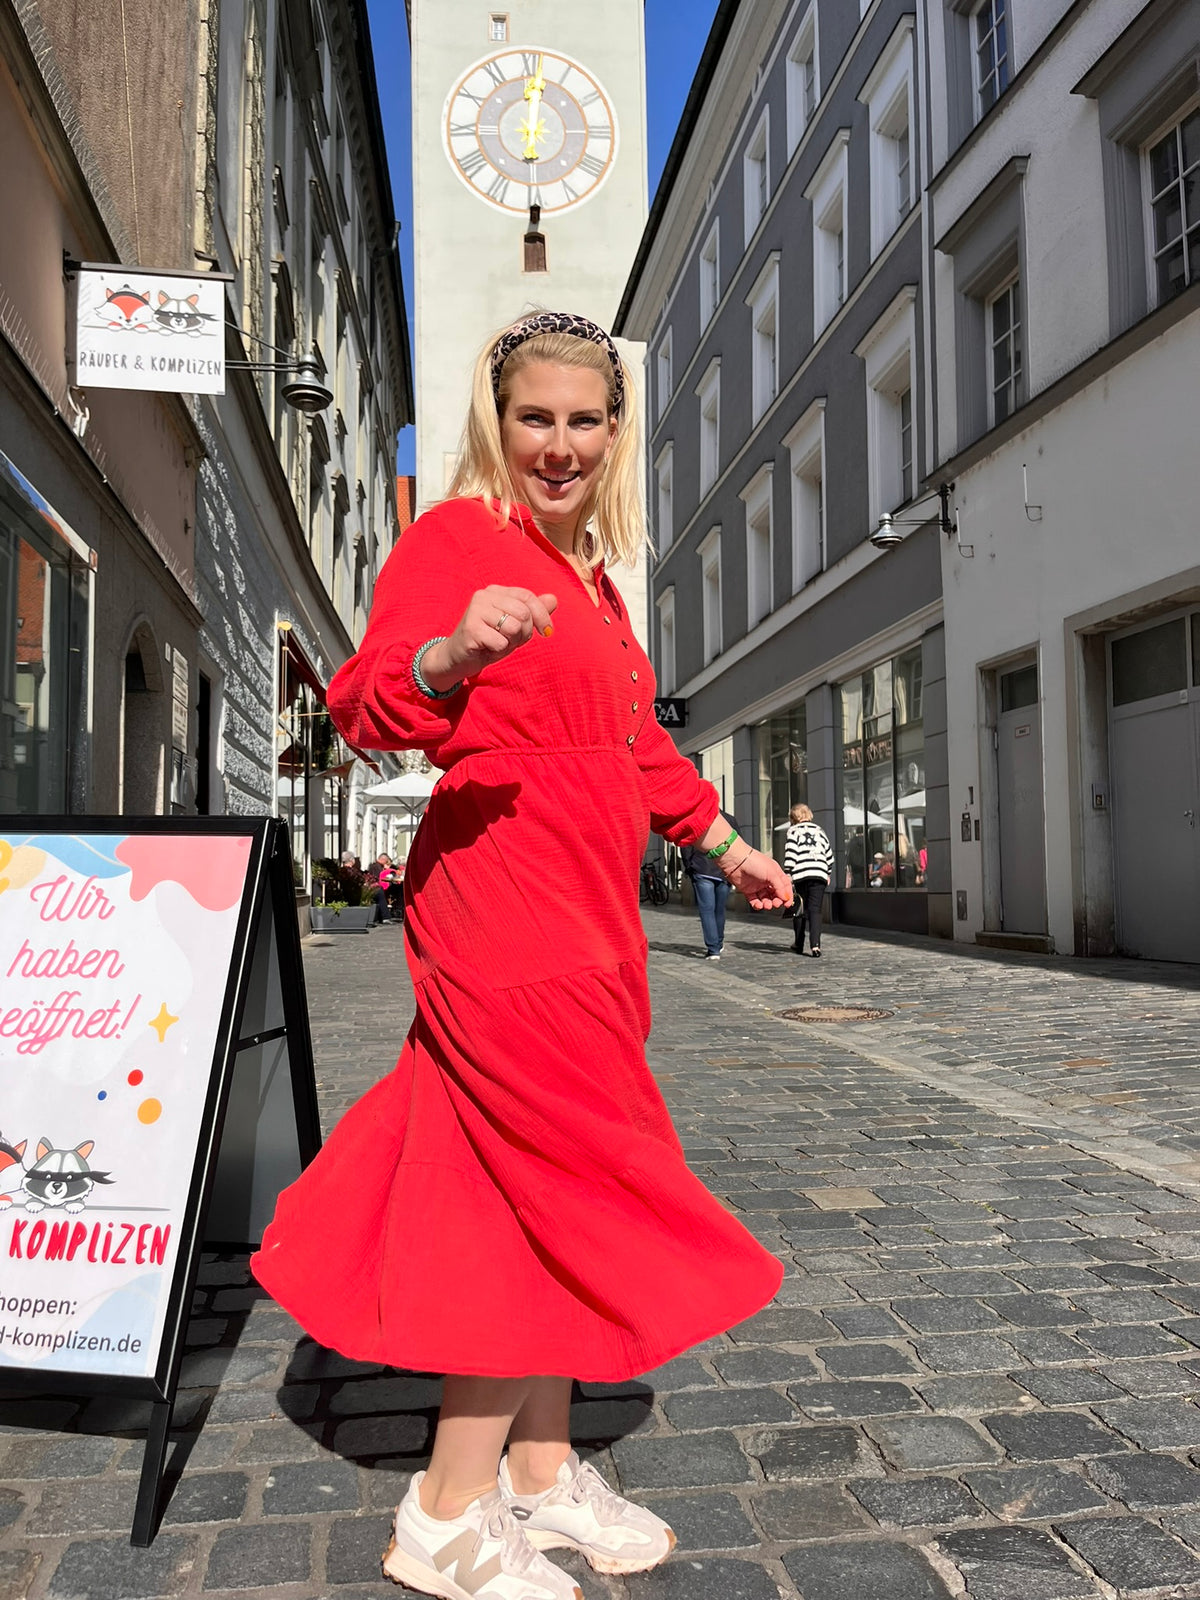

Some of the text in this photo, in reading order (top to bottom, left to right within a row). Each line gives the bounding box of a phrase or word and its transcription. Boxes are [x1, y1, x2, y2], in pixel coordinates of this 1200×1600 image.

[457, 87, 488, 108] X
[587, 126, 611, 139] III
[79, 350, 128, 369] RÄUBER
[134, 355, 145, 371] &
[30, 875, 116, 922] Wir
[6, 939, 126, 979] haben
[0, 991, 142, 1055] eöffnet!
